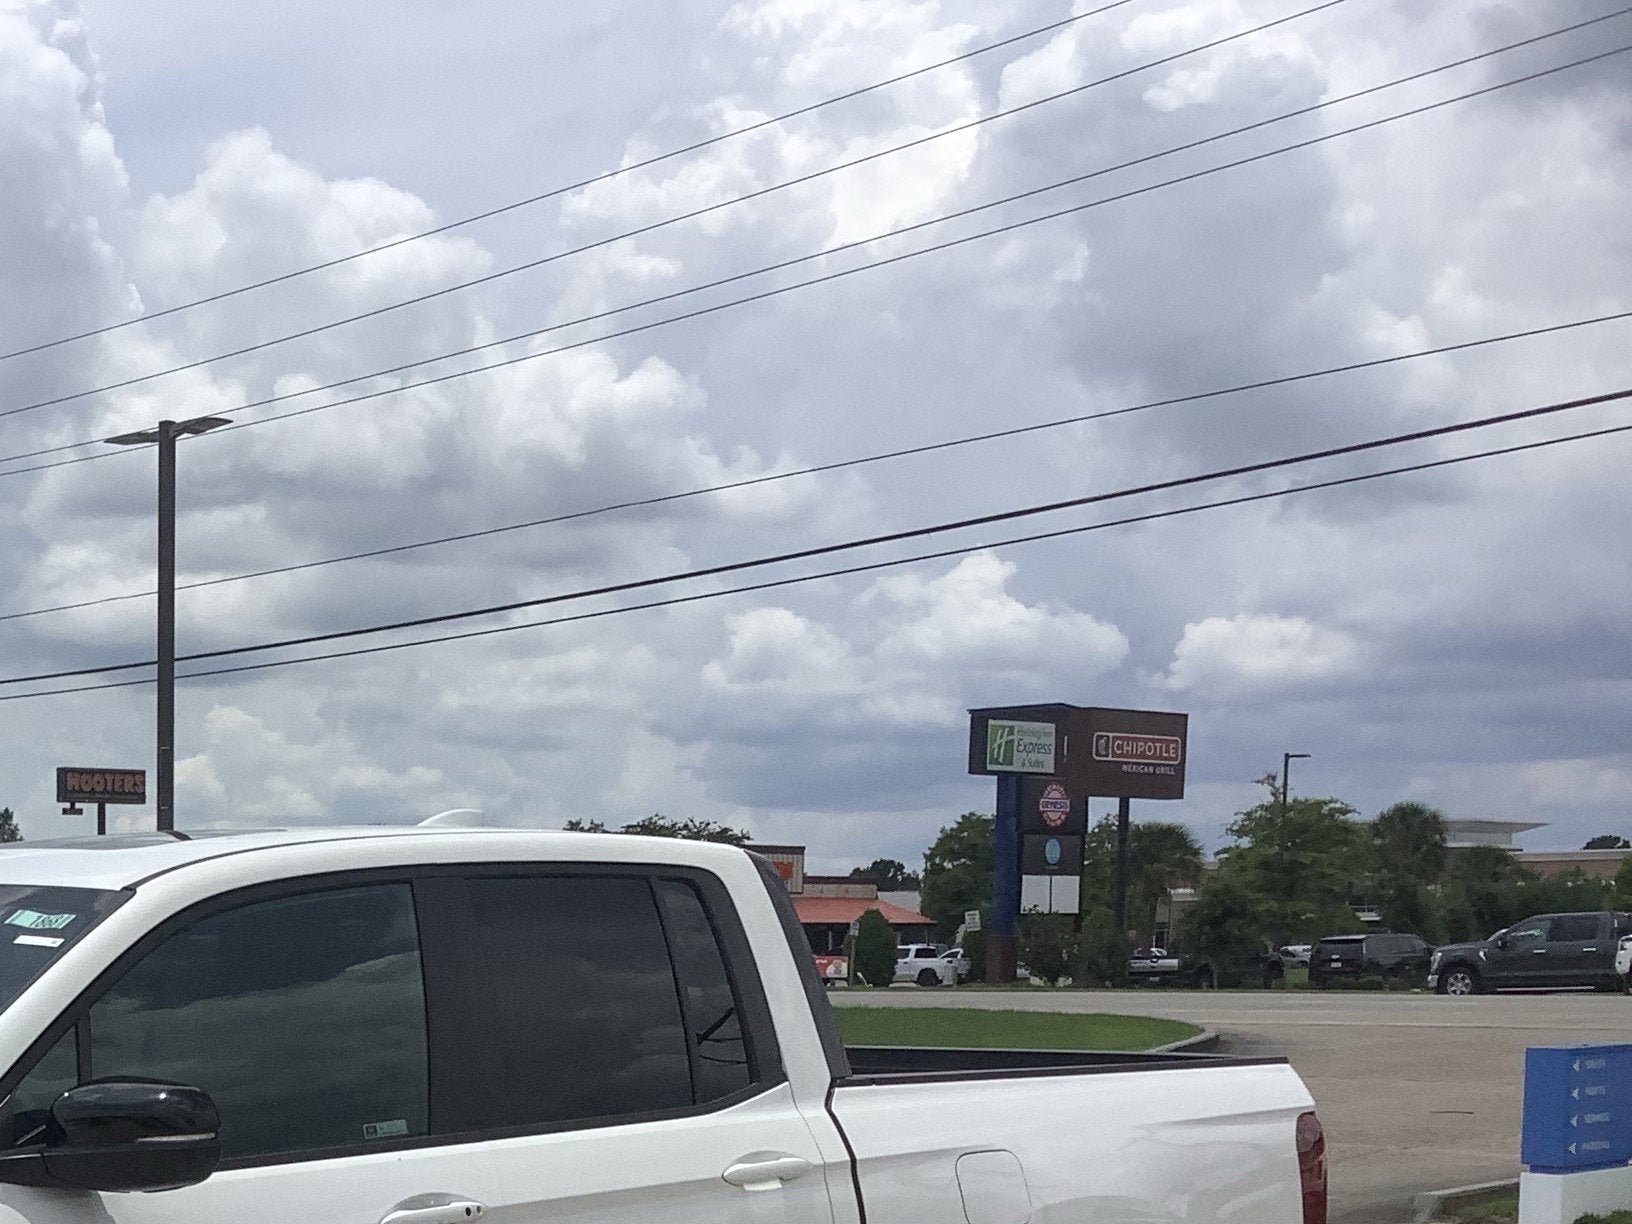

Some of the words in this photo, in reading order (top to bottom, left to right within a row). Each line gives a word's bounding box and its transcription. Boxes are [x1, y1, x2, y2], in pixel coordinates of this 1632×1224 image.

[1017, 738, 1052, 757] Express
[1113, 740, 1177, 758] CHIPOTLE
[1121, 763, 1154, 775] MEXICAN
[1155, 765, 1175, 775] GRILL
[66, 772, 144, 793] HOOTERS
